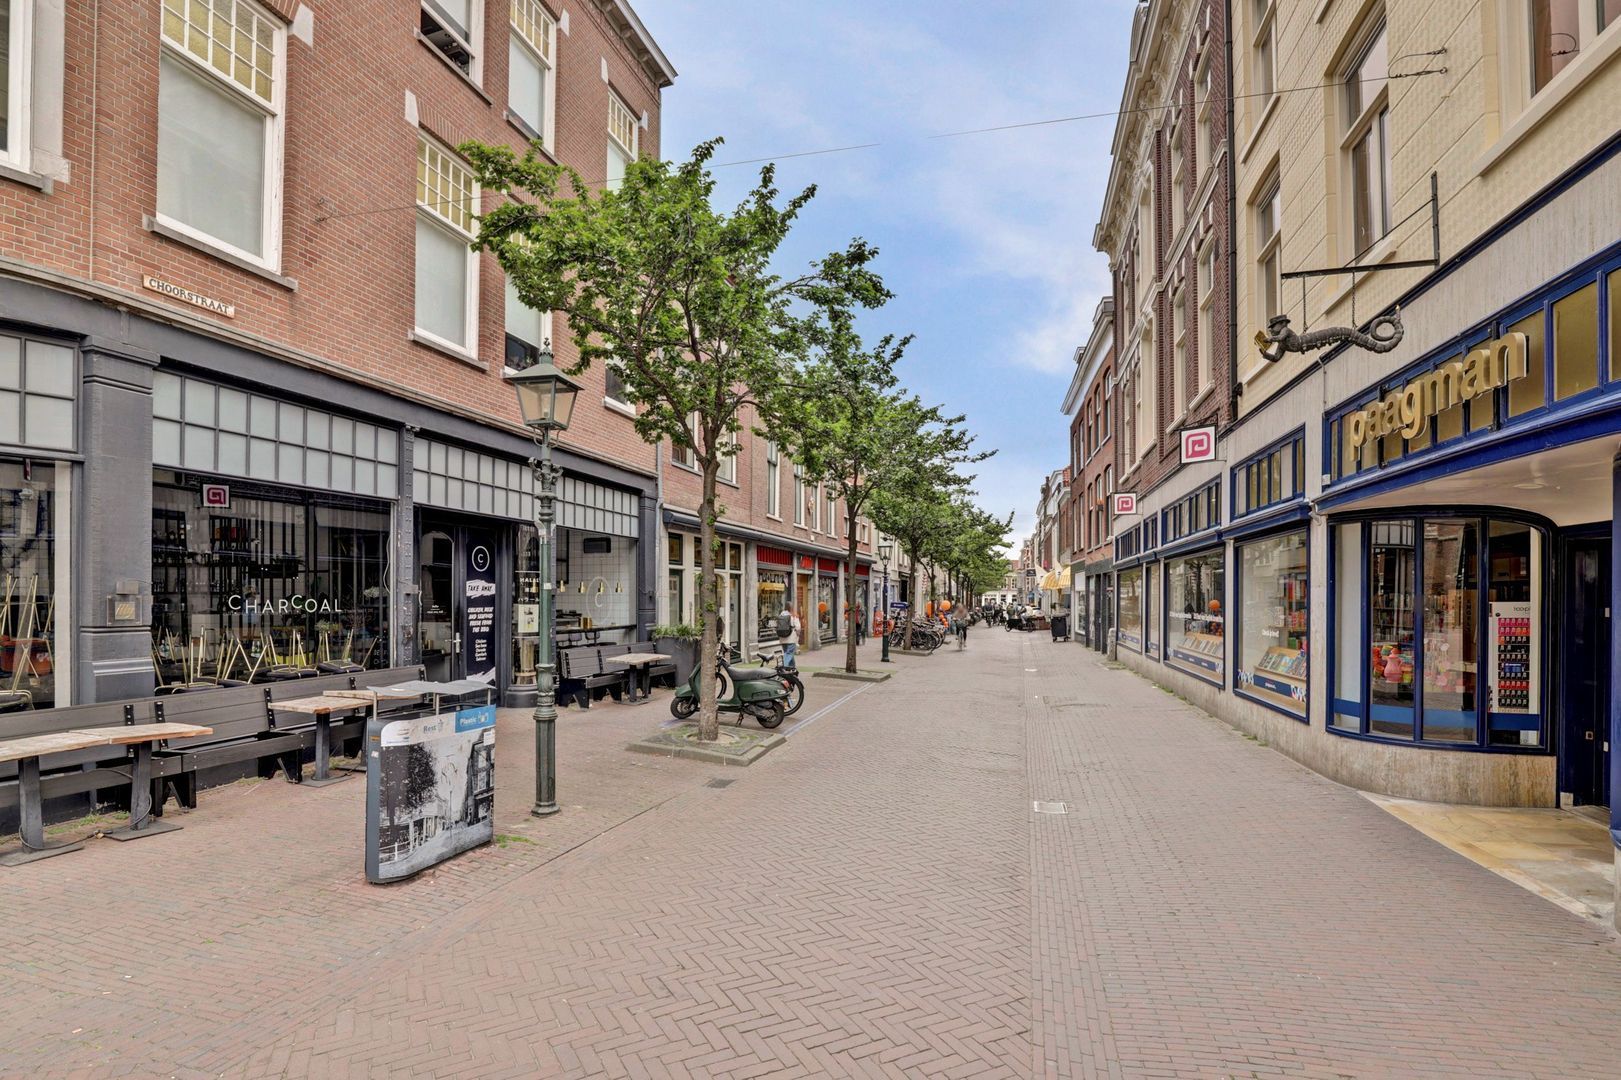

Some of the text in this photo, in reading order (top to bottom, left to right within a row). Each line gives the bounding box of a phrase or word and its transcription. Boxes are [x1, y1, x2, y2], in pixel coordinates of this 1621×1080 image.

[149, 278, 229, 314] CHOORSTRAAT
[1350, 332, 1527, 462] paagman
[467, 584, 480, 592] TAKE
